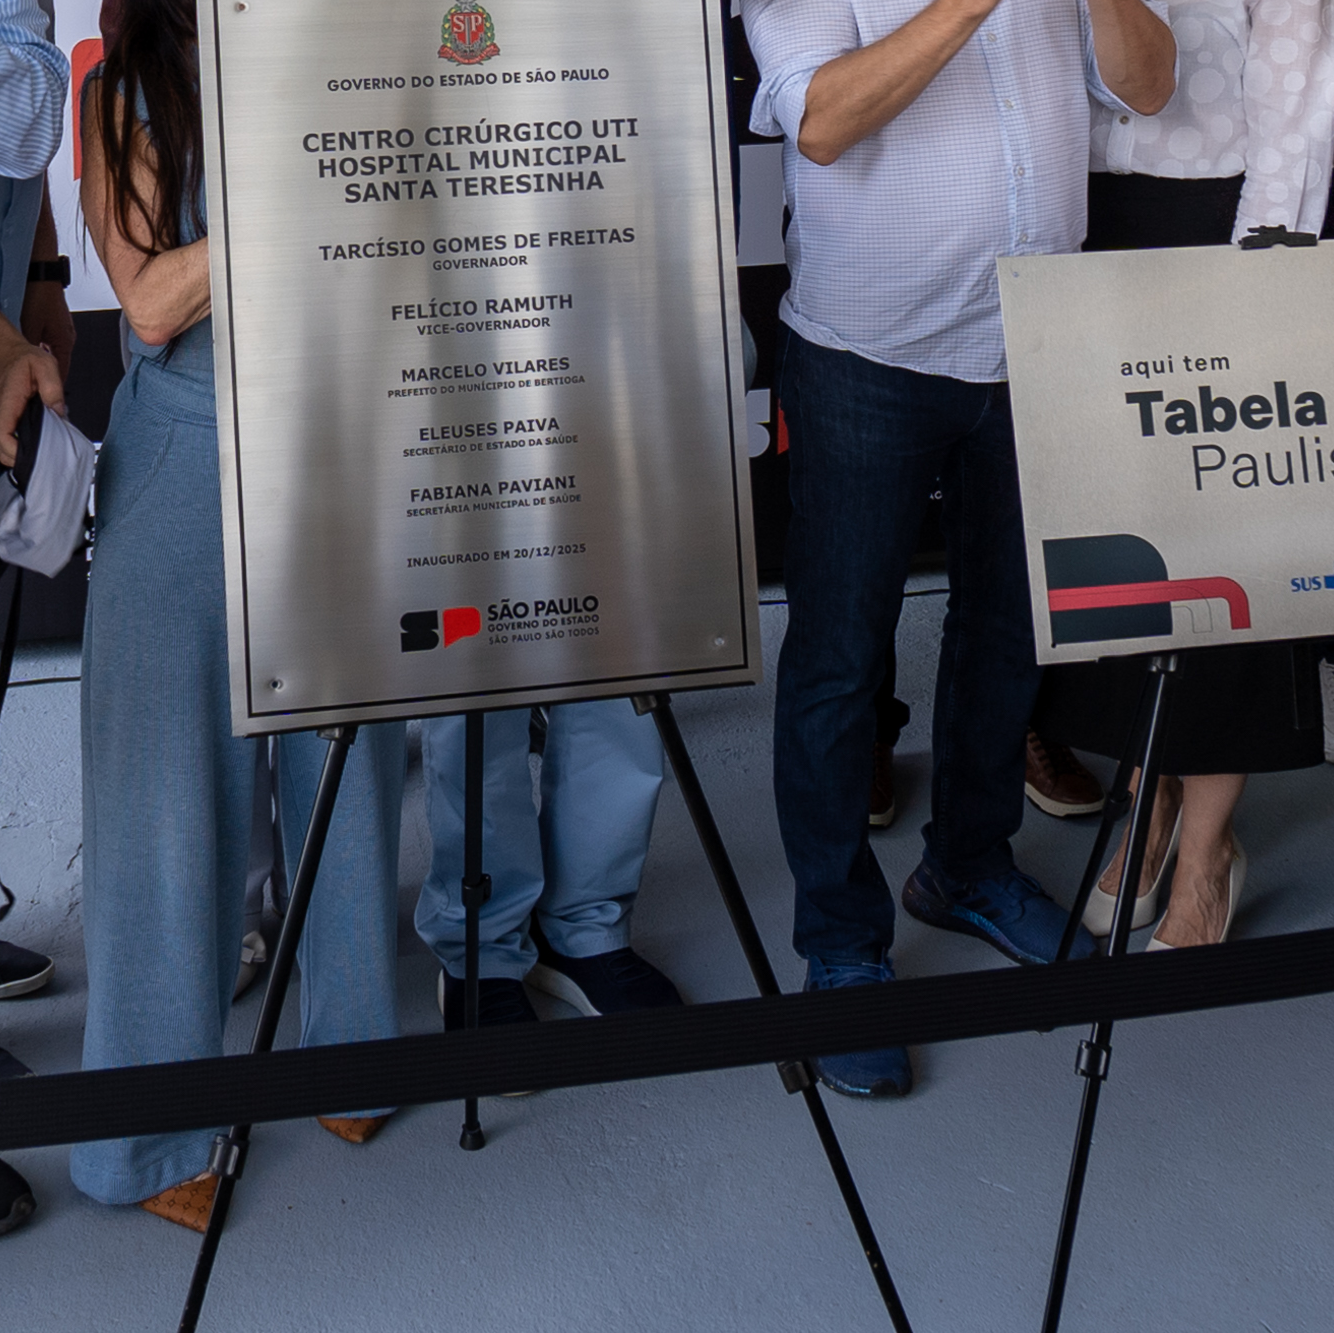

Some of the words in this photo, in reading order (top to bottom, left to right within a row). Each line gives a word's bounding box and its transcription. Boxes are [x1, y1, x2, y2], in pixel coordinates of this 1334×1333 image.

[327, 76, 406, 91] GOVERNO
[411, 75, 434, 88] DO
[439, 72, 497, 86] ESTADO
[502, 72, 521, 84] DE
[526, 68, 556, 83] SÃO
[561, 68, 609, 81] PAULO
[302, 128, 414, 152] CENTRO
[424, 118, 582, 146] CIRÚRGICO
[592, 117, 638, 138] UTI
[318, 152, 460, 178] HOSPITAL
[469, 144, 626, 170] MUNICIPAL
[345, 179, 438, 203] SANTA
[445, 170, 604, 197] TERESINHA
[318, 236, 425, 261] TARCÍSIO
[432, 234, 507, 254] GOMES
[514, 232, 541, 249] DE
[548, 227, 635, 247] FREITAS
[432, 255, 528, 271] GOVERNADOR
[391, 297, 477, 320] FELÍCIO
[485, 293, 573, 314] RAMUTH
[416, 316, 551, 335] VICE-GOVERNADOR
[401, 363, 487, 382] MARCELO
[492, 356, 570, 375] VILARES
[1120, 359, 1173, 379] aqui
[1182, 355, 1230, 372] tem
[387, 386, 437, 398] PREFEITO
[440, 385, 455, 394] DO
[518, 379, 531, 388] DE
[534, 375, 585, 386] BERTIOGA
[1124, 380, 1327, 437] Tabela
[419, 421, 497, 441] ELEUSES
[503, 417, 560, 434] PAIVA
[402, 443, 467, 457] SECRETÁRIO
[469, 442, 483, 452] DE
[486, 439, 526, 450] ESTADO
[528, 438, 543, 447] DA
[544, 434, 578, 445] SAÚDE
[410, 482, 492, 502] FABIANA
[498, 474, 576, 495] PAVIANI
[406, 503, 470, 517] SECRETÁRIA
[472, 498, 530, 511] MUNICIPAL
[532, 496, 546, 506] DE
[548, 493, 581, 504] SAÚDE
[407, 551, 490, 568] INAUGURADO
[493, 550, 510, 560] EM
[513, 542, 586, 559] 20/12/2025
[487, 598, 529, 621] SÃO
[534, 595, 599, 617] PAULO
